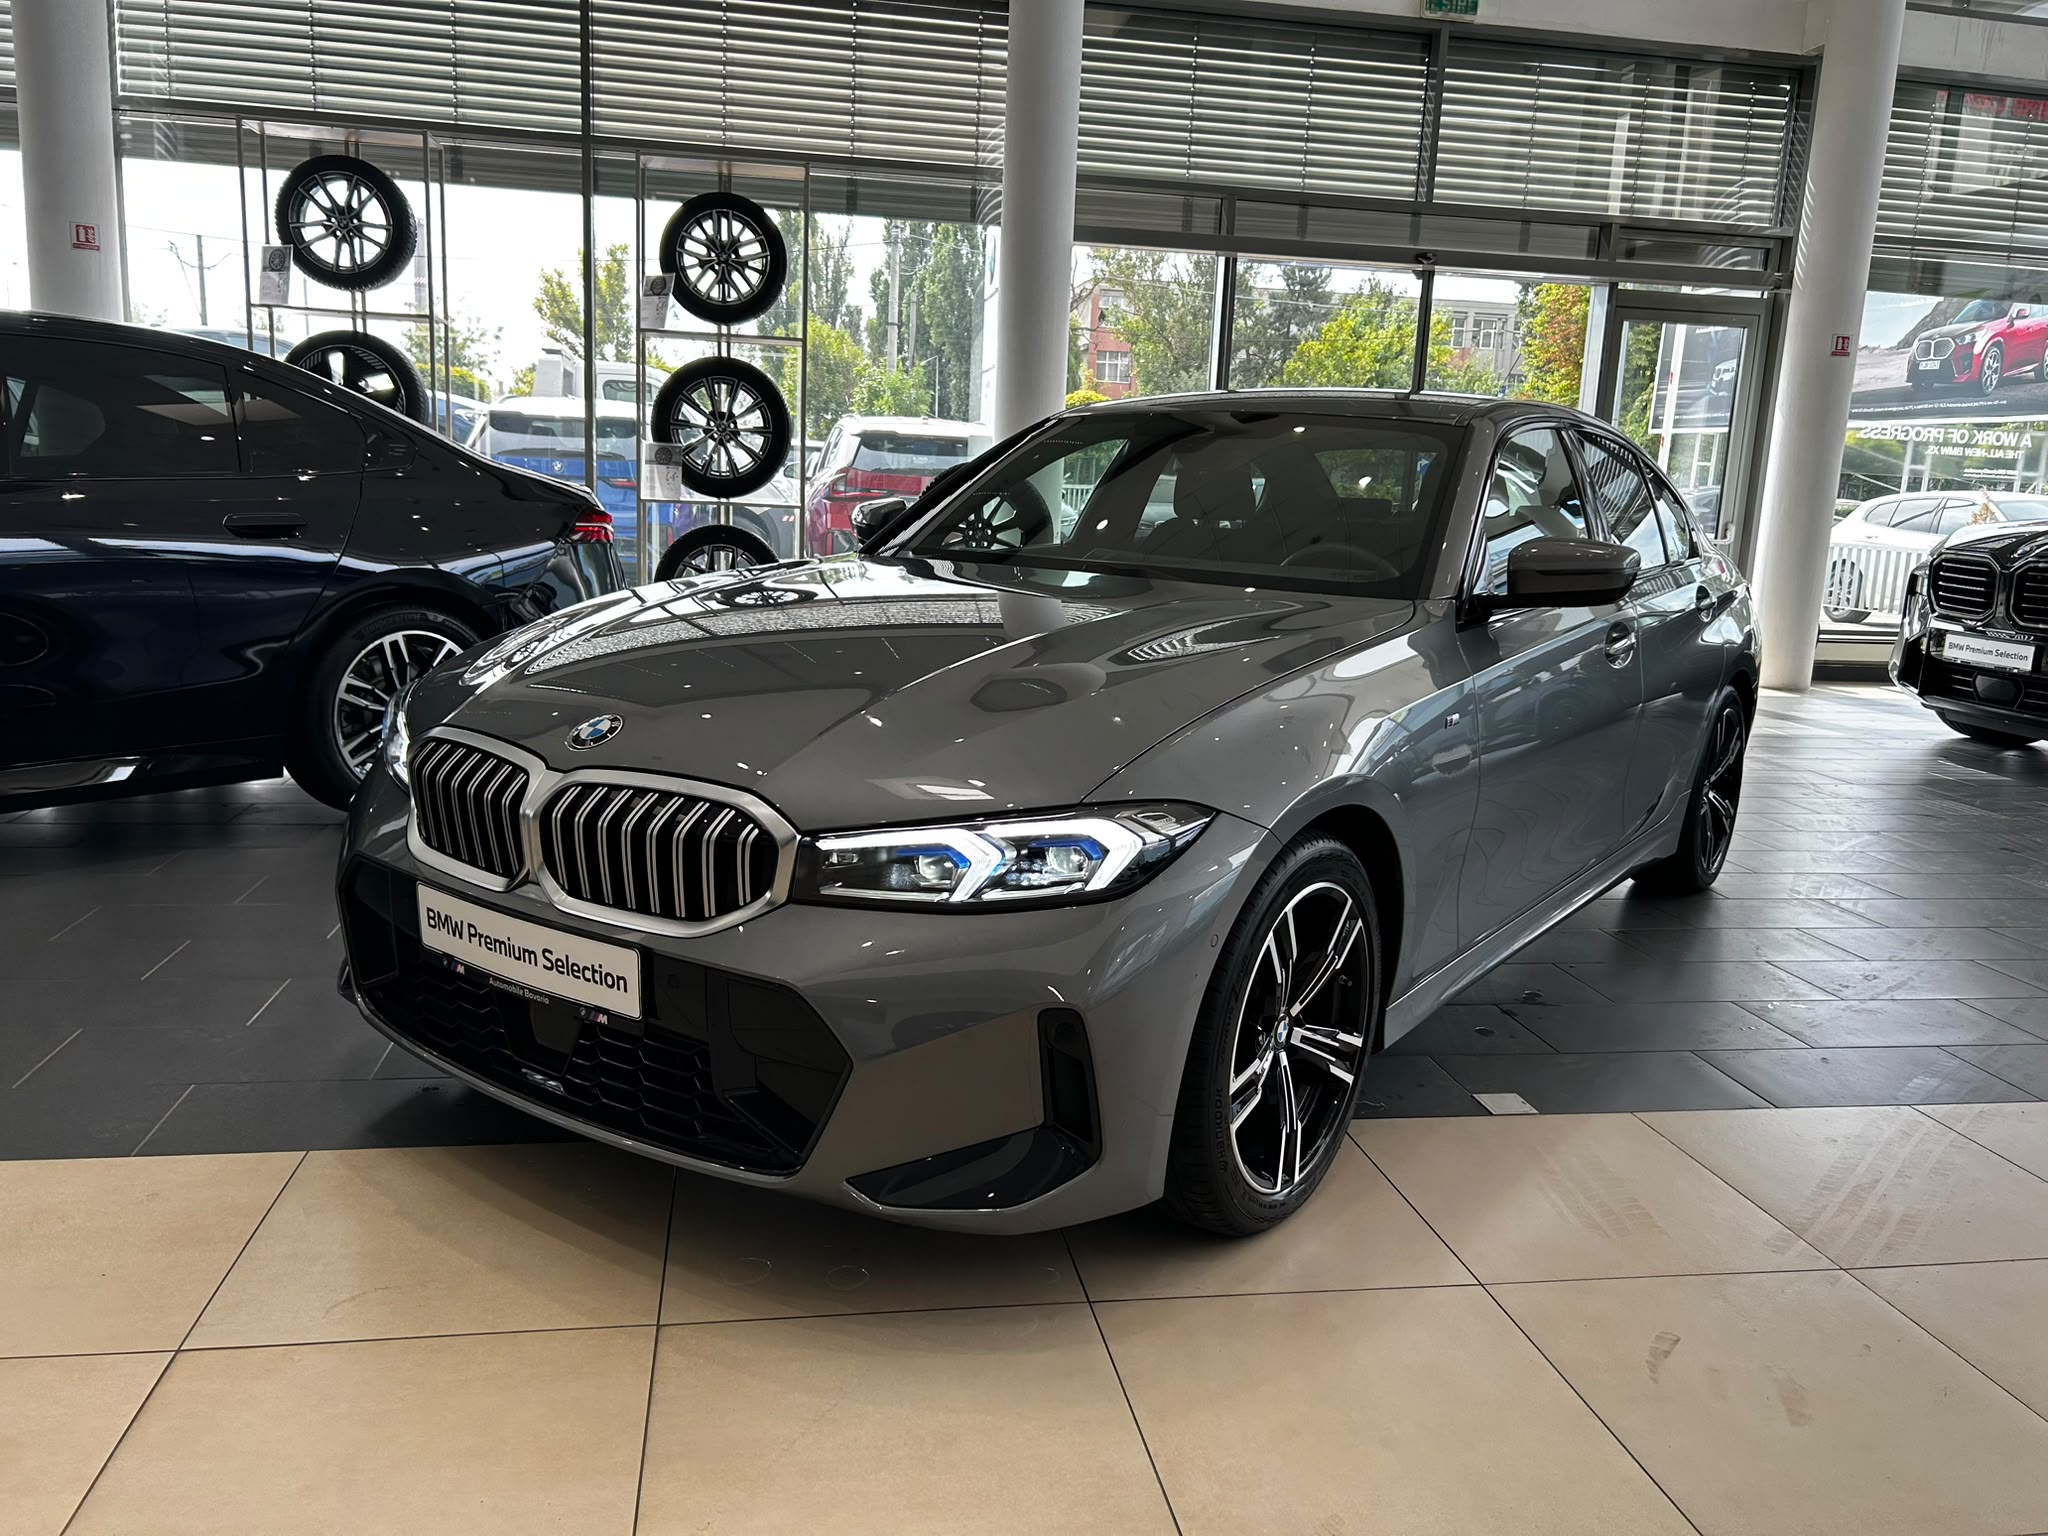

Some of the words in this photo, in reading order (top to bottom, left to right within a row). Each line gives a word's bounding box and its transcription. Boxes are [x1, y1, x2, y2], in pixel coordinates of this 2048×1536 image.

[1948, 641, 1965, 651] BMW
[1965, 644, 1993, 656] Premium
[1994, 648, 2028, 661] Selection
[426, 906, 464, 940] BMW
[467, 922, 538, 967] Premium
[542, 948, 628, 993] Selection
[489, 977, 524, 996] Automobile
[524, 988, 550, 1004] Bavaria
